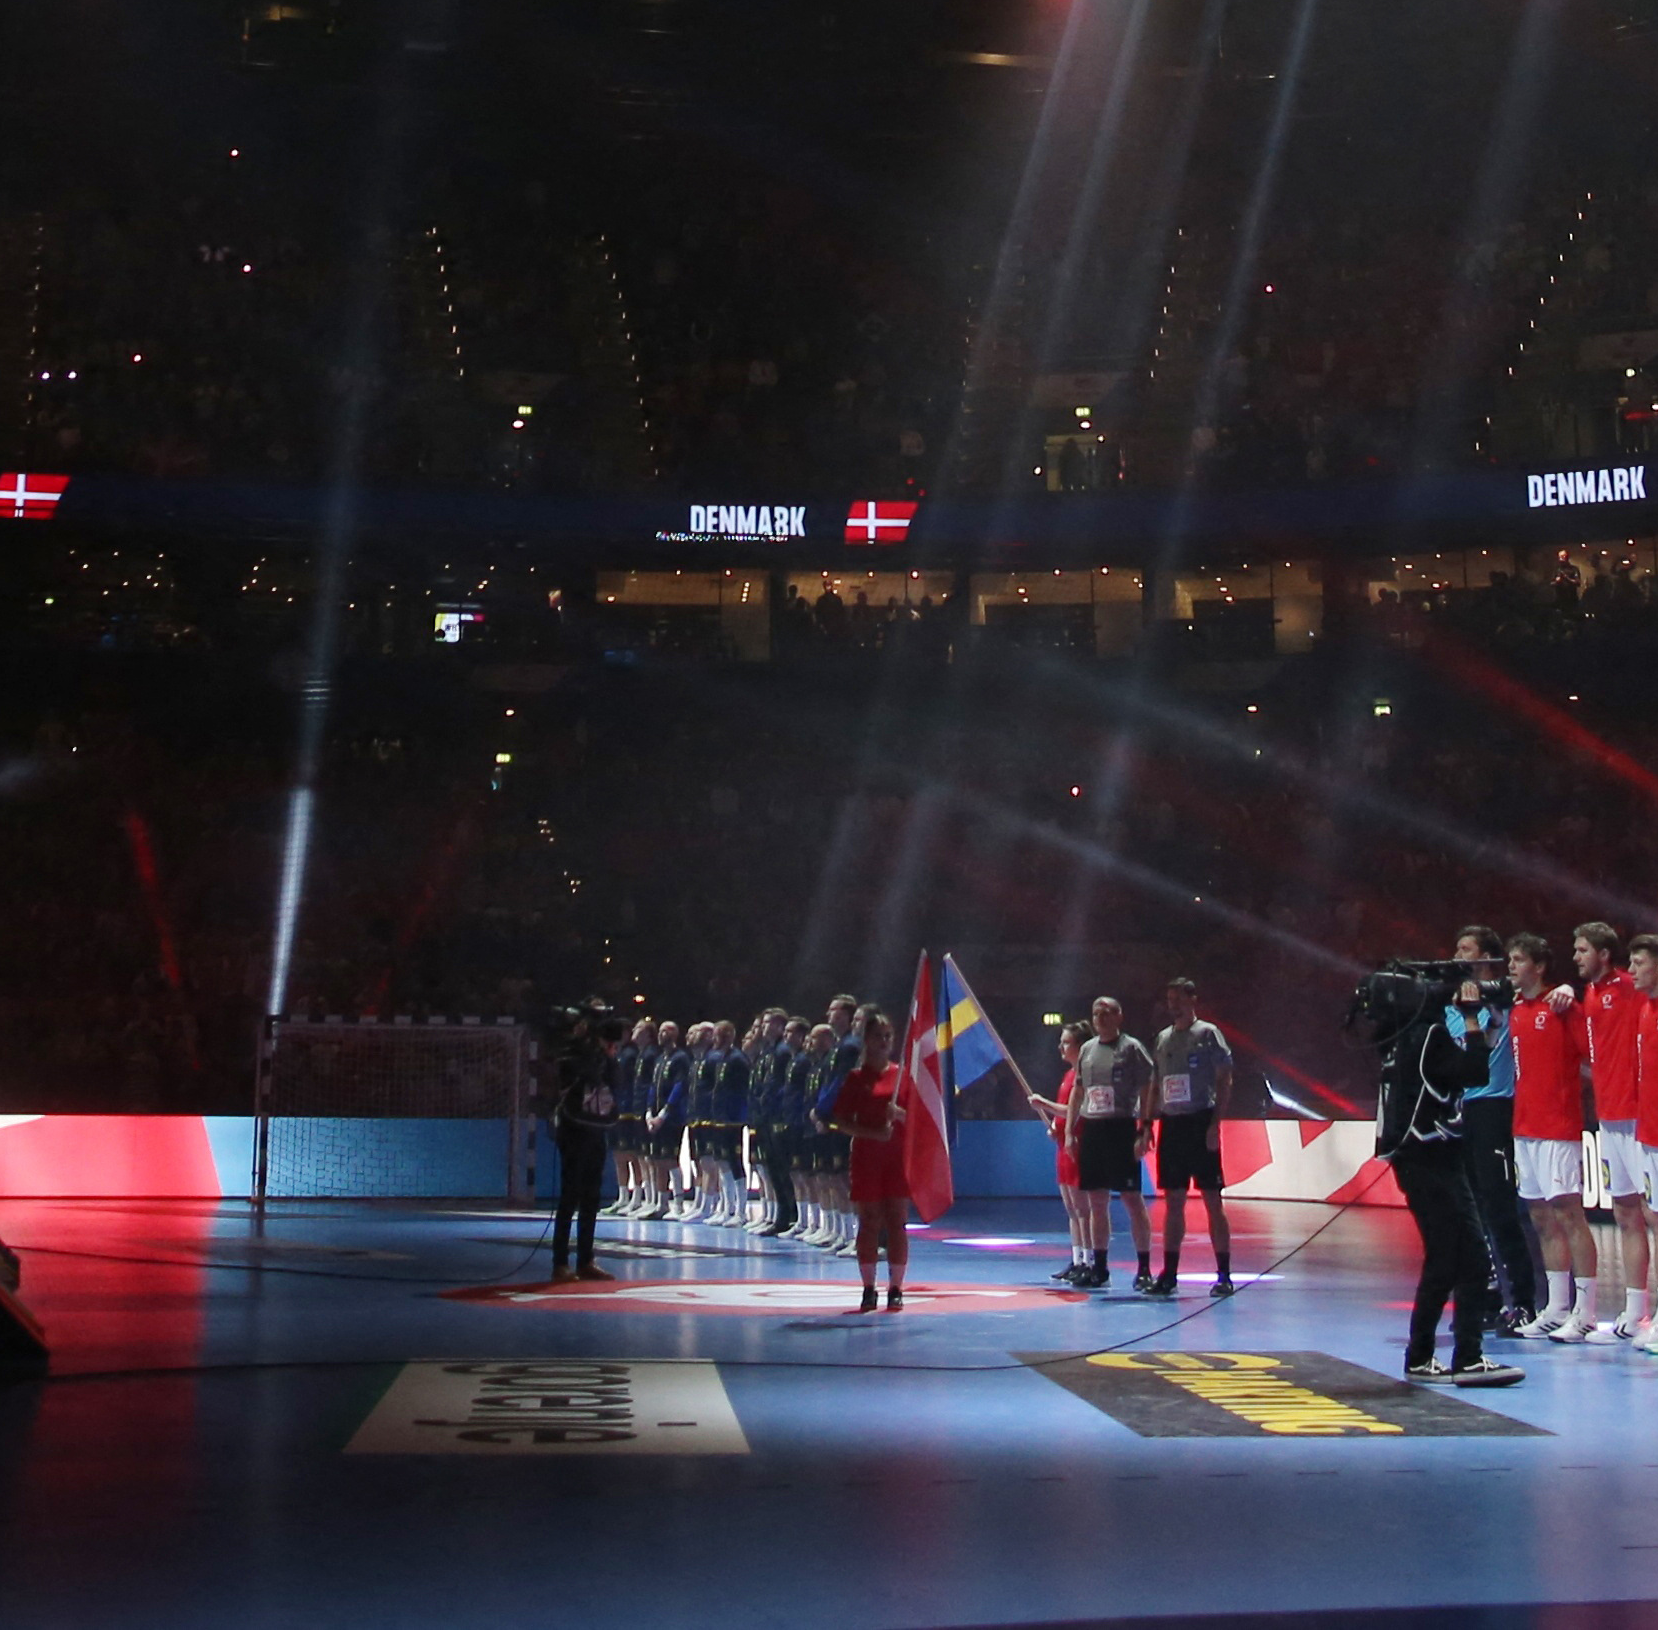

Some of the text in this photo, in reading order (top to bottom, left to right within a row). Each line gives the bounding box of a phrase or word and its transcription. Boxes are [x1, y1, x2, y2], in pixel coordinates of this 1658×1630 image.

[1528, 466, 1645, 508] DENMARK
[690, 505, 806, 536] DENMARK
[1153, 1370, 1405, 1434] HARTING
